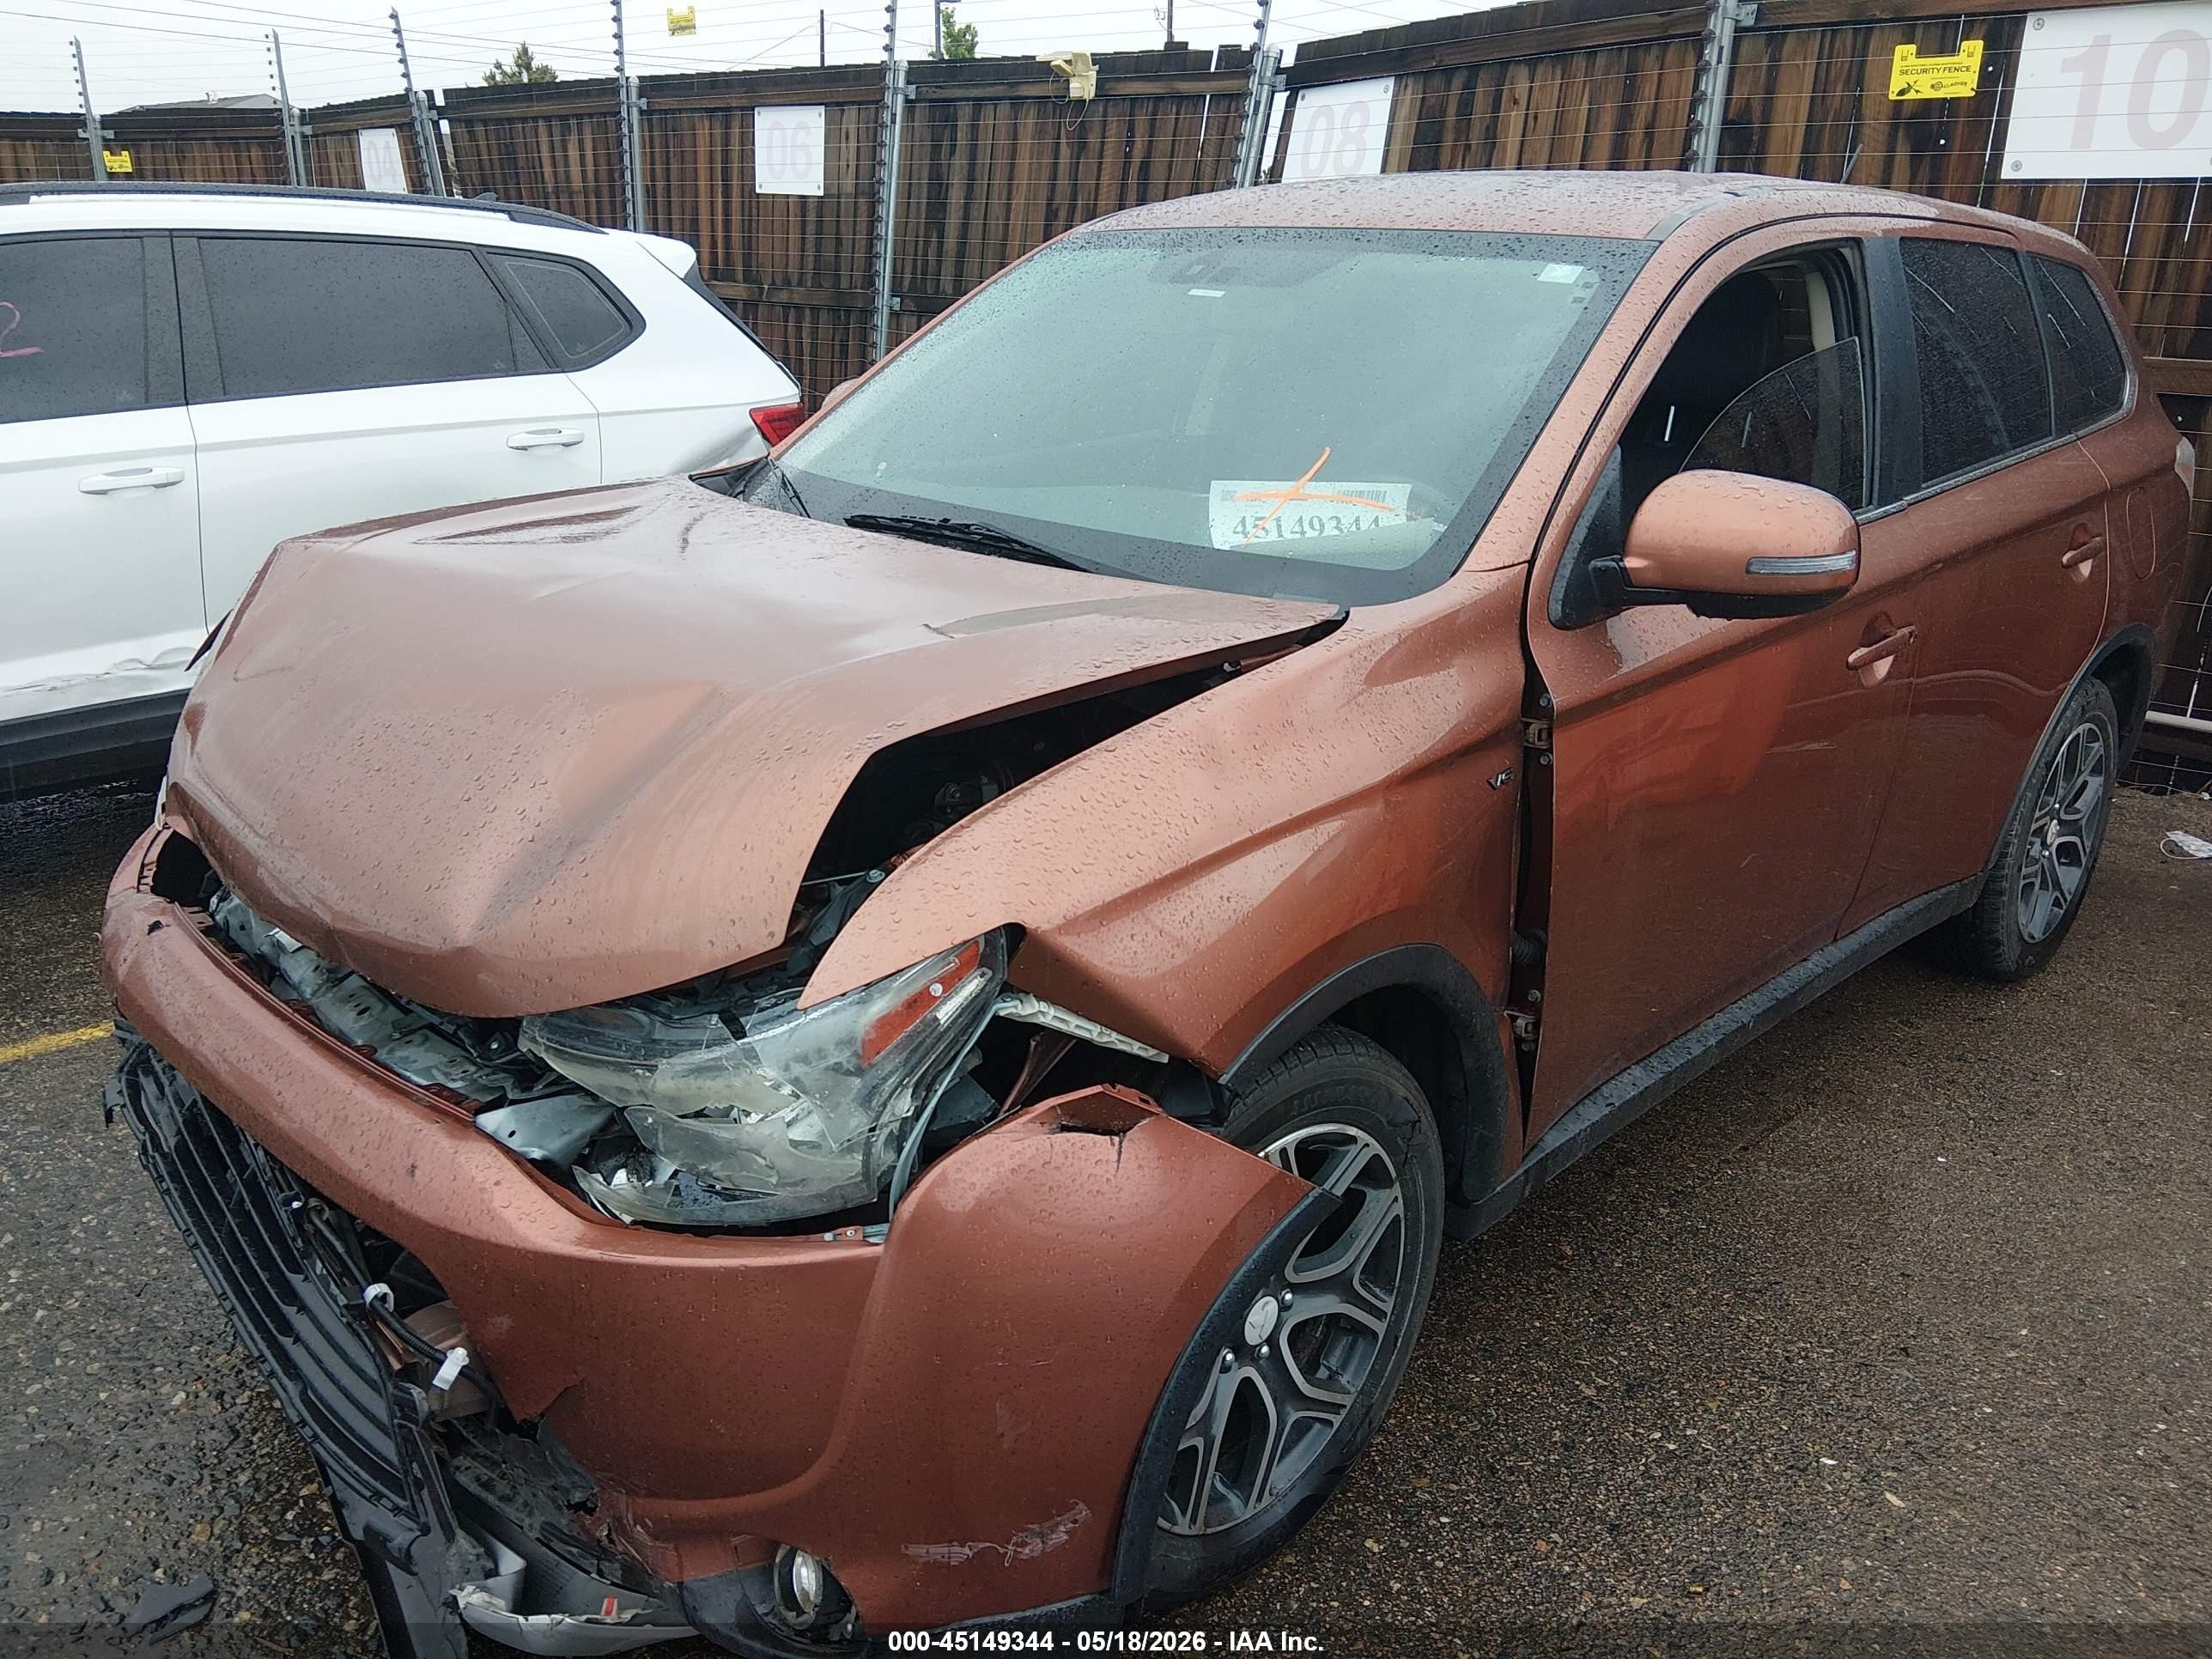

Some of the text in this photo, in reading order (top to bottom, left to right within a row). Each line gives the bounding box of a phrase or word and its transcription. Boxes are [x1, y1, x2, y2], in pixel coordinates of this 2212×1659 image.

[1899, 67, 1942, 76] SECURITY
[1943, 64, 1972, 74] FENCE
[2060, 28, 2211, 149] 10
[766, 118, 813, 180] 06
[1301, 101, 1370, 176] 08
